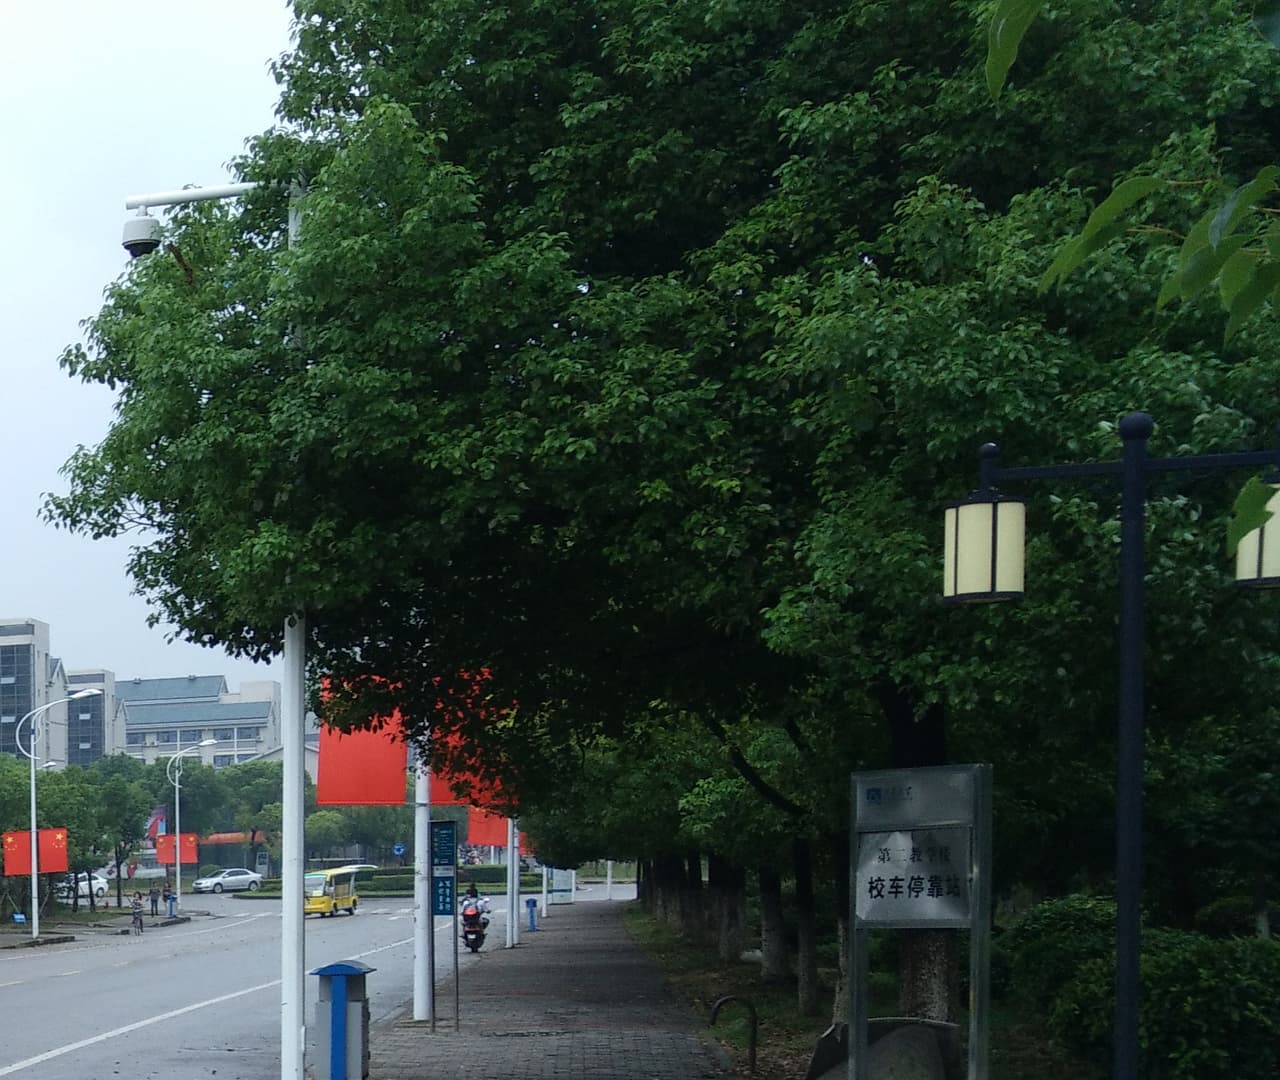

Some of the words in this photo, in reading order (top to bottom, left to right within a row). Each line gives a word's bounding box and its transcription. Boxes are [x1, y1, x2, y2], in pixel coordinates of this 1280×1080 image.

[867, 873, 961, 900] 校车停靠站
